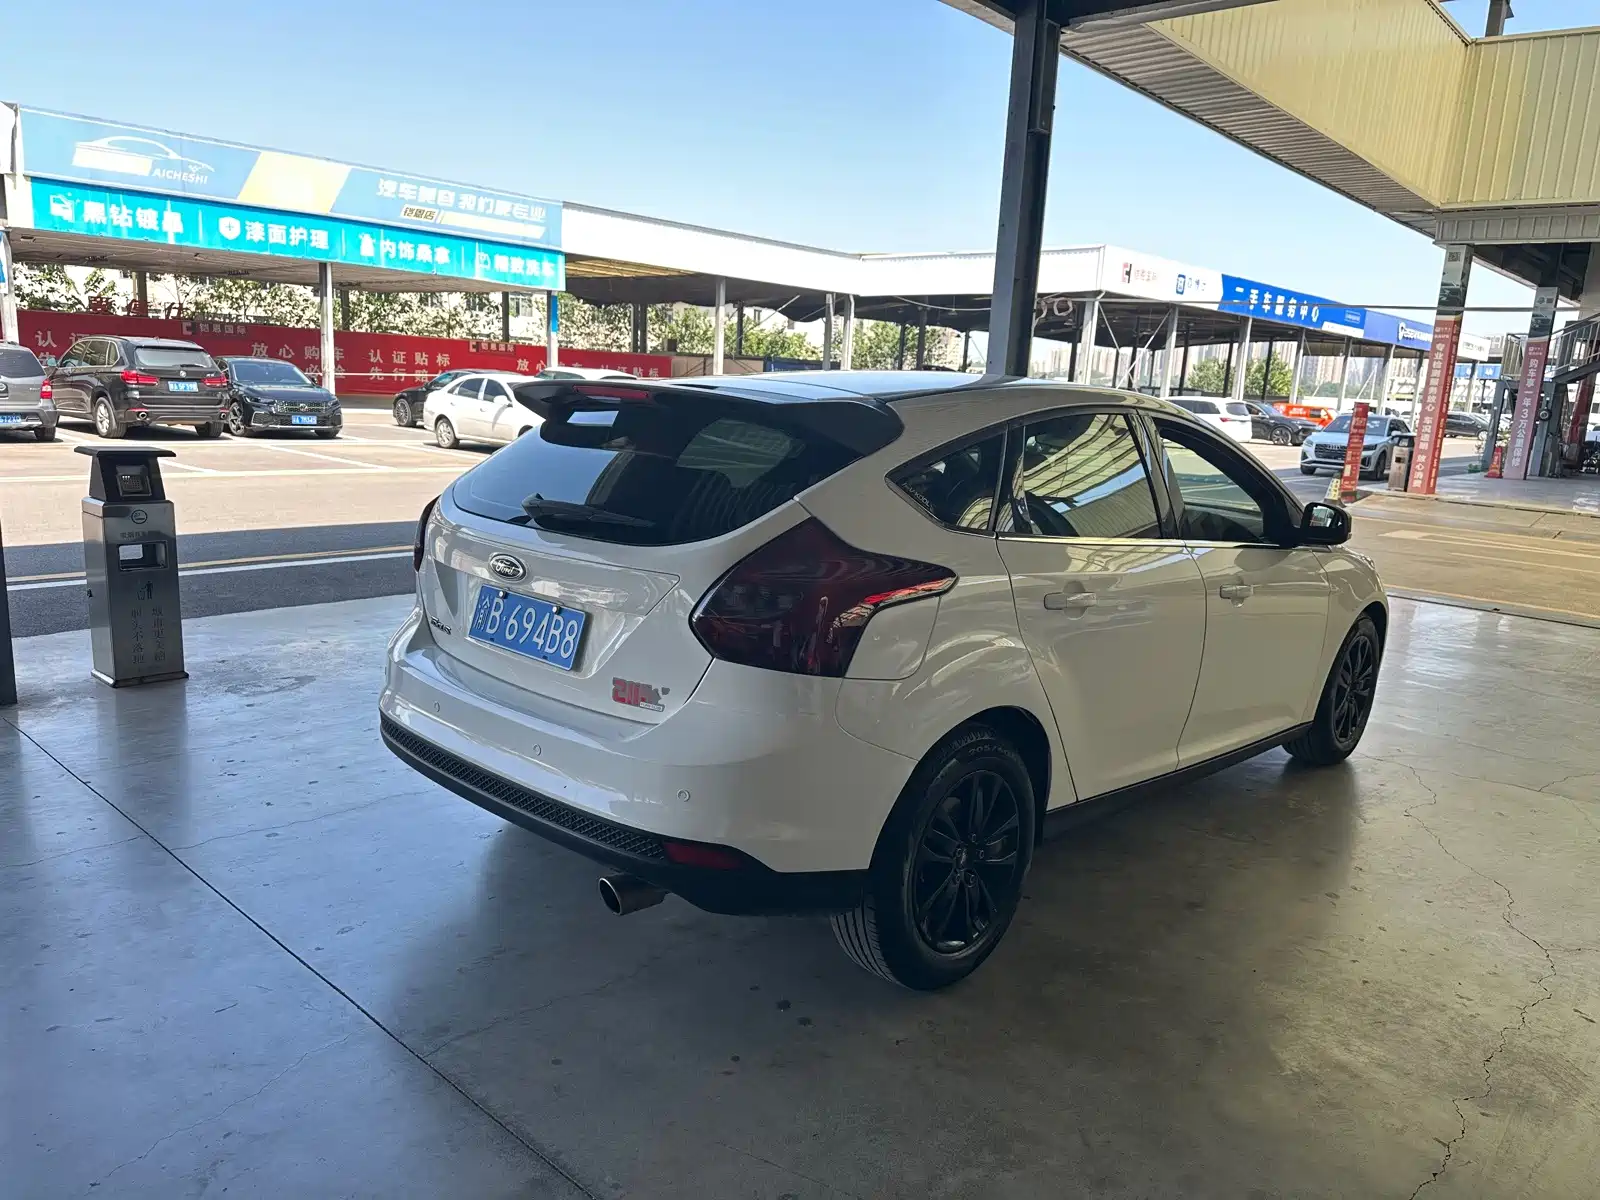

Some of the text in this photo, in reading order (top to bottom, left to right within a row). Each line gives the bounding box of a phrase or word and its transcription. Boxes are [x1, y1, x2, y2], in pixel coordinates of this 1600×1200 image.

[152, 168, 208, 184] AICHESHI
[245, 221, 329, 250] 漆面护理
[369, 349, 450, 366] 认证贴标
